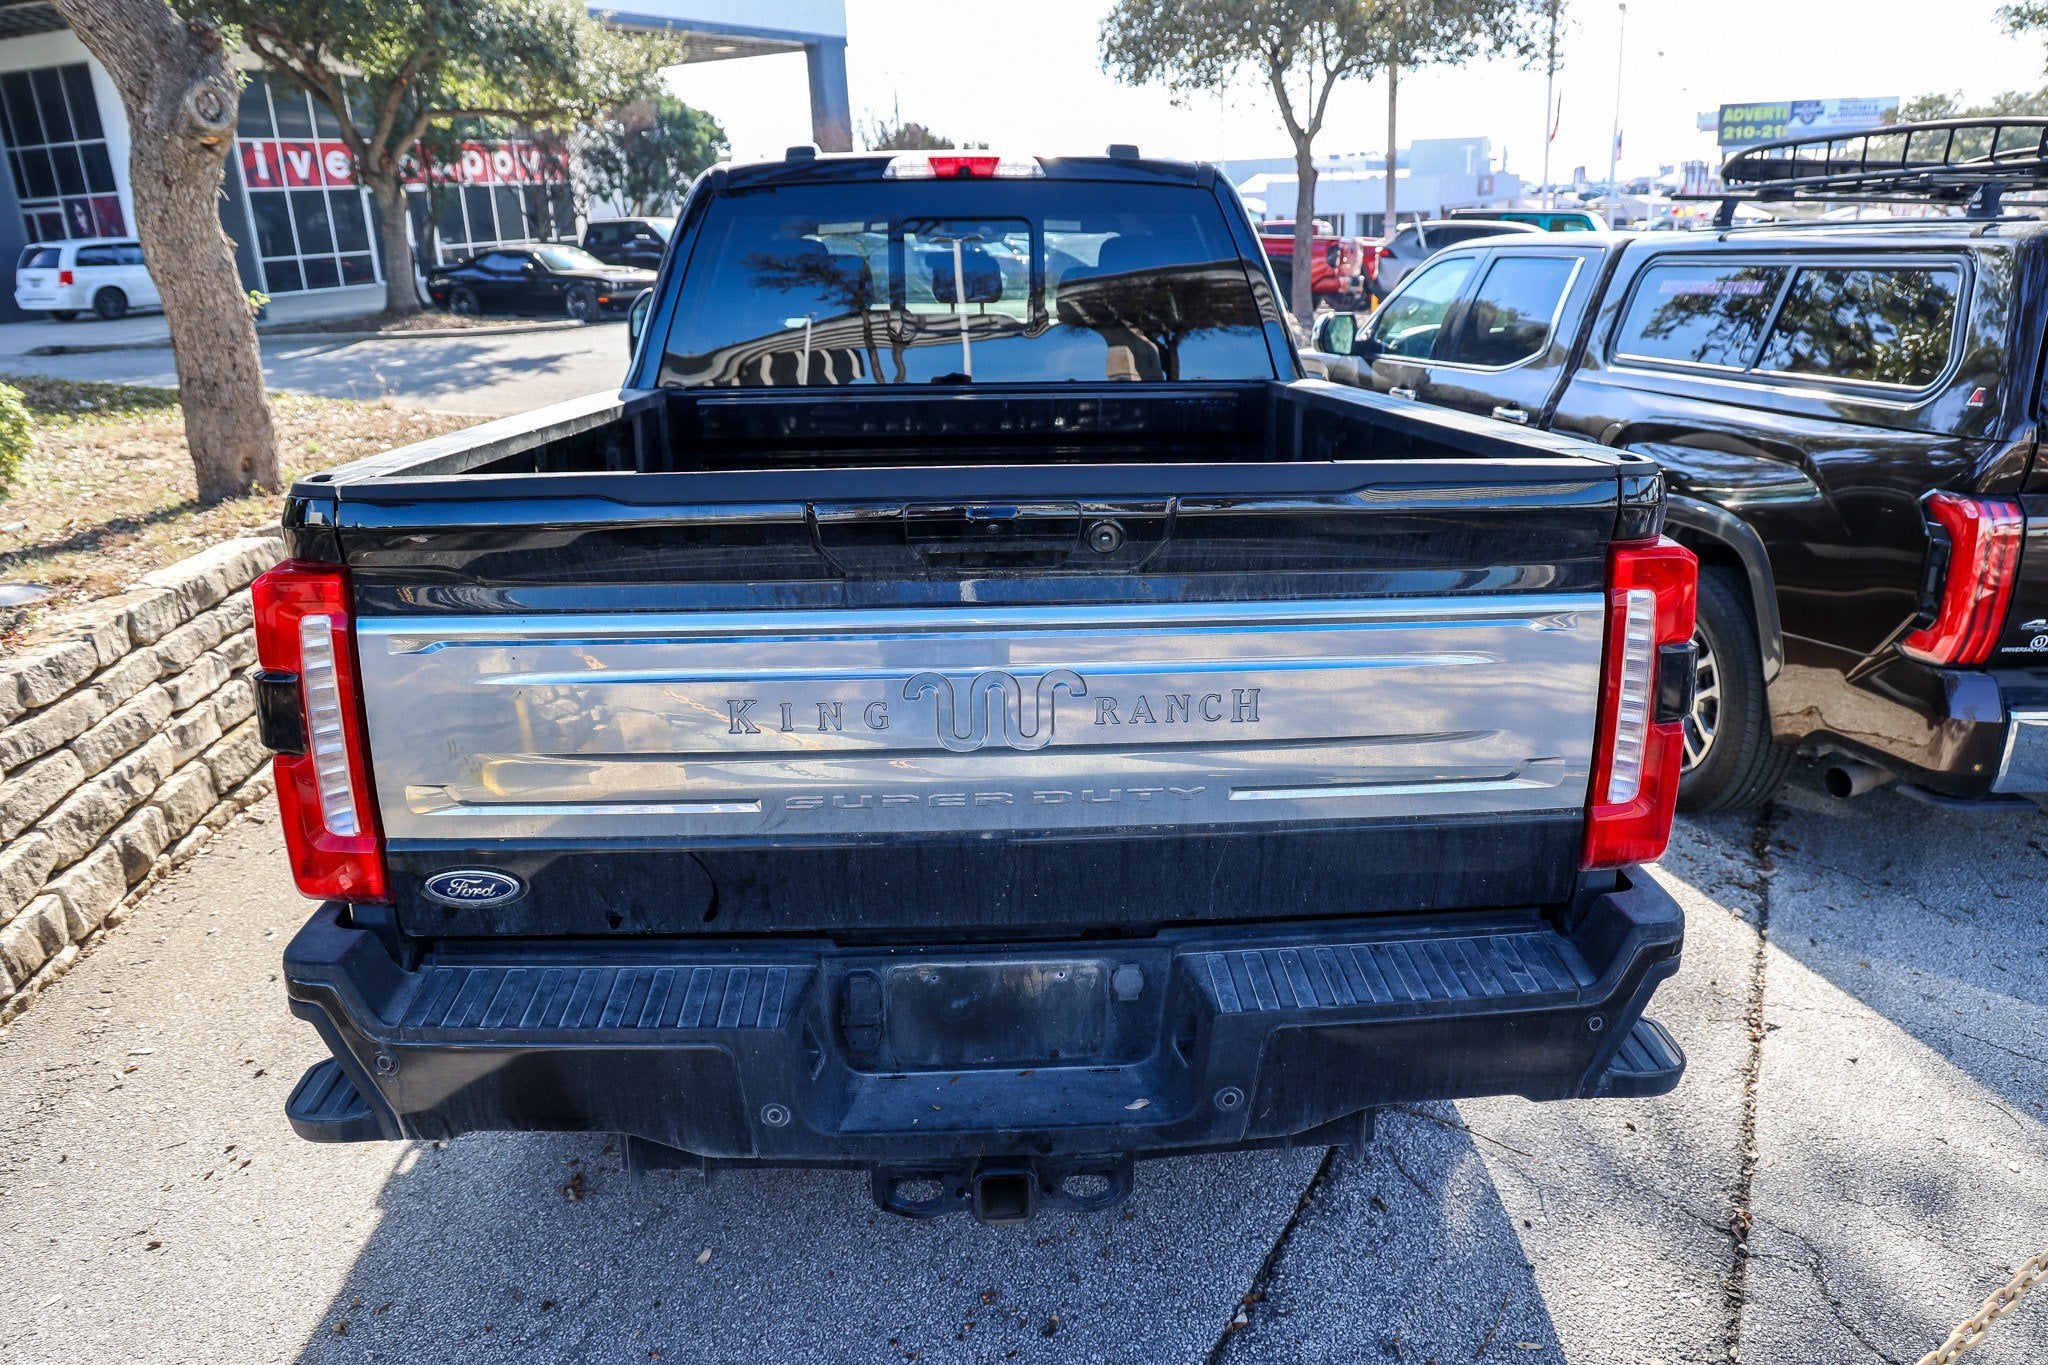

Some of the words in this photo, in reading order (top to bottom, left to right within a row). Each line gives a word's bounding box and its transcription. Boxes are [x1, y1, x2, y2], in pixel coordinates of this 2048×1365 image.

[726, 699, 890, 734] KING
[1093, 688, 1262, 726] RANCH
[785, 791, 1013, 810] SUPER
[1033, 785, 1206, 805] DUTY
[446, 878, 497, 897] Ford
